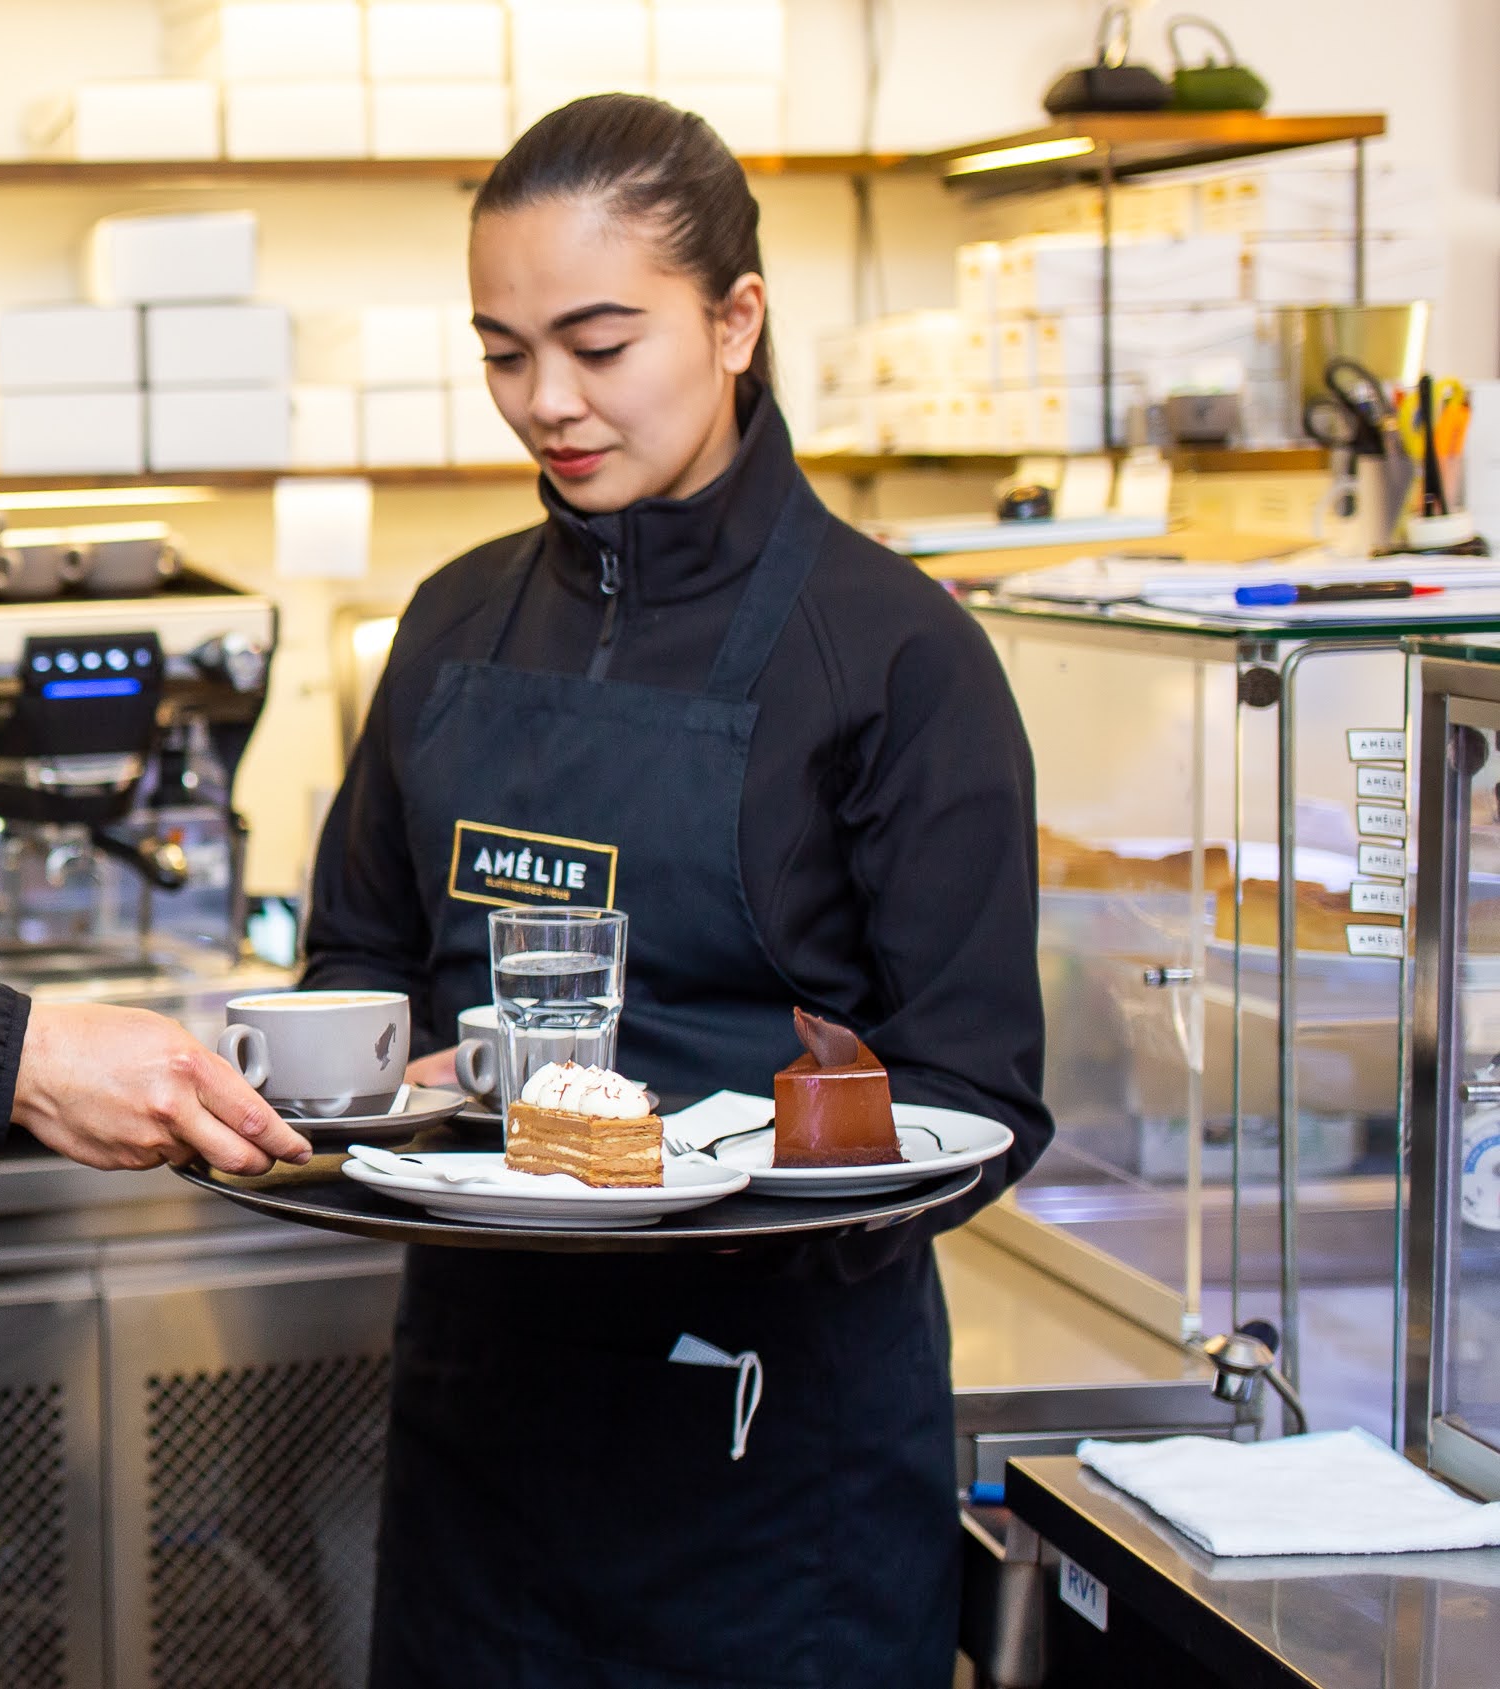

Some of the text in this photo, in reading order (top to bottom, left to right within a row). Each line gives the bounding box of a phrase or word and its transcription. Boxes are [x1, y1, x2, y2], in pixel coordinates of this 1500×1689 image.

[1361, 736, 1402, 750] AMÉLIE
[1366, 776, 1402, 790] AMÉLIE
[1367, 813, 1402, 827] AMÉLIE
[473, 847, 587, 890] AMÉLIE
[1068, 1563, 1097, 1609] RV1
